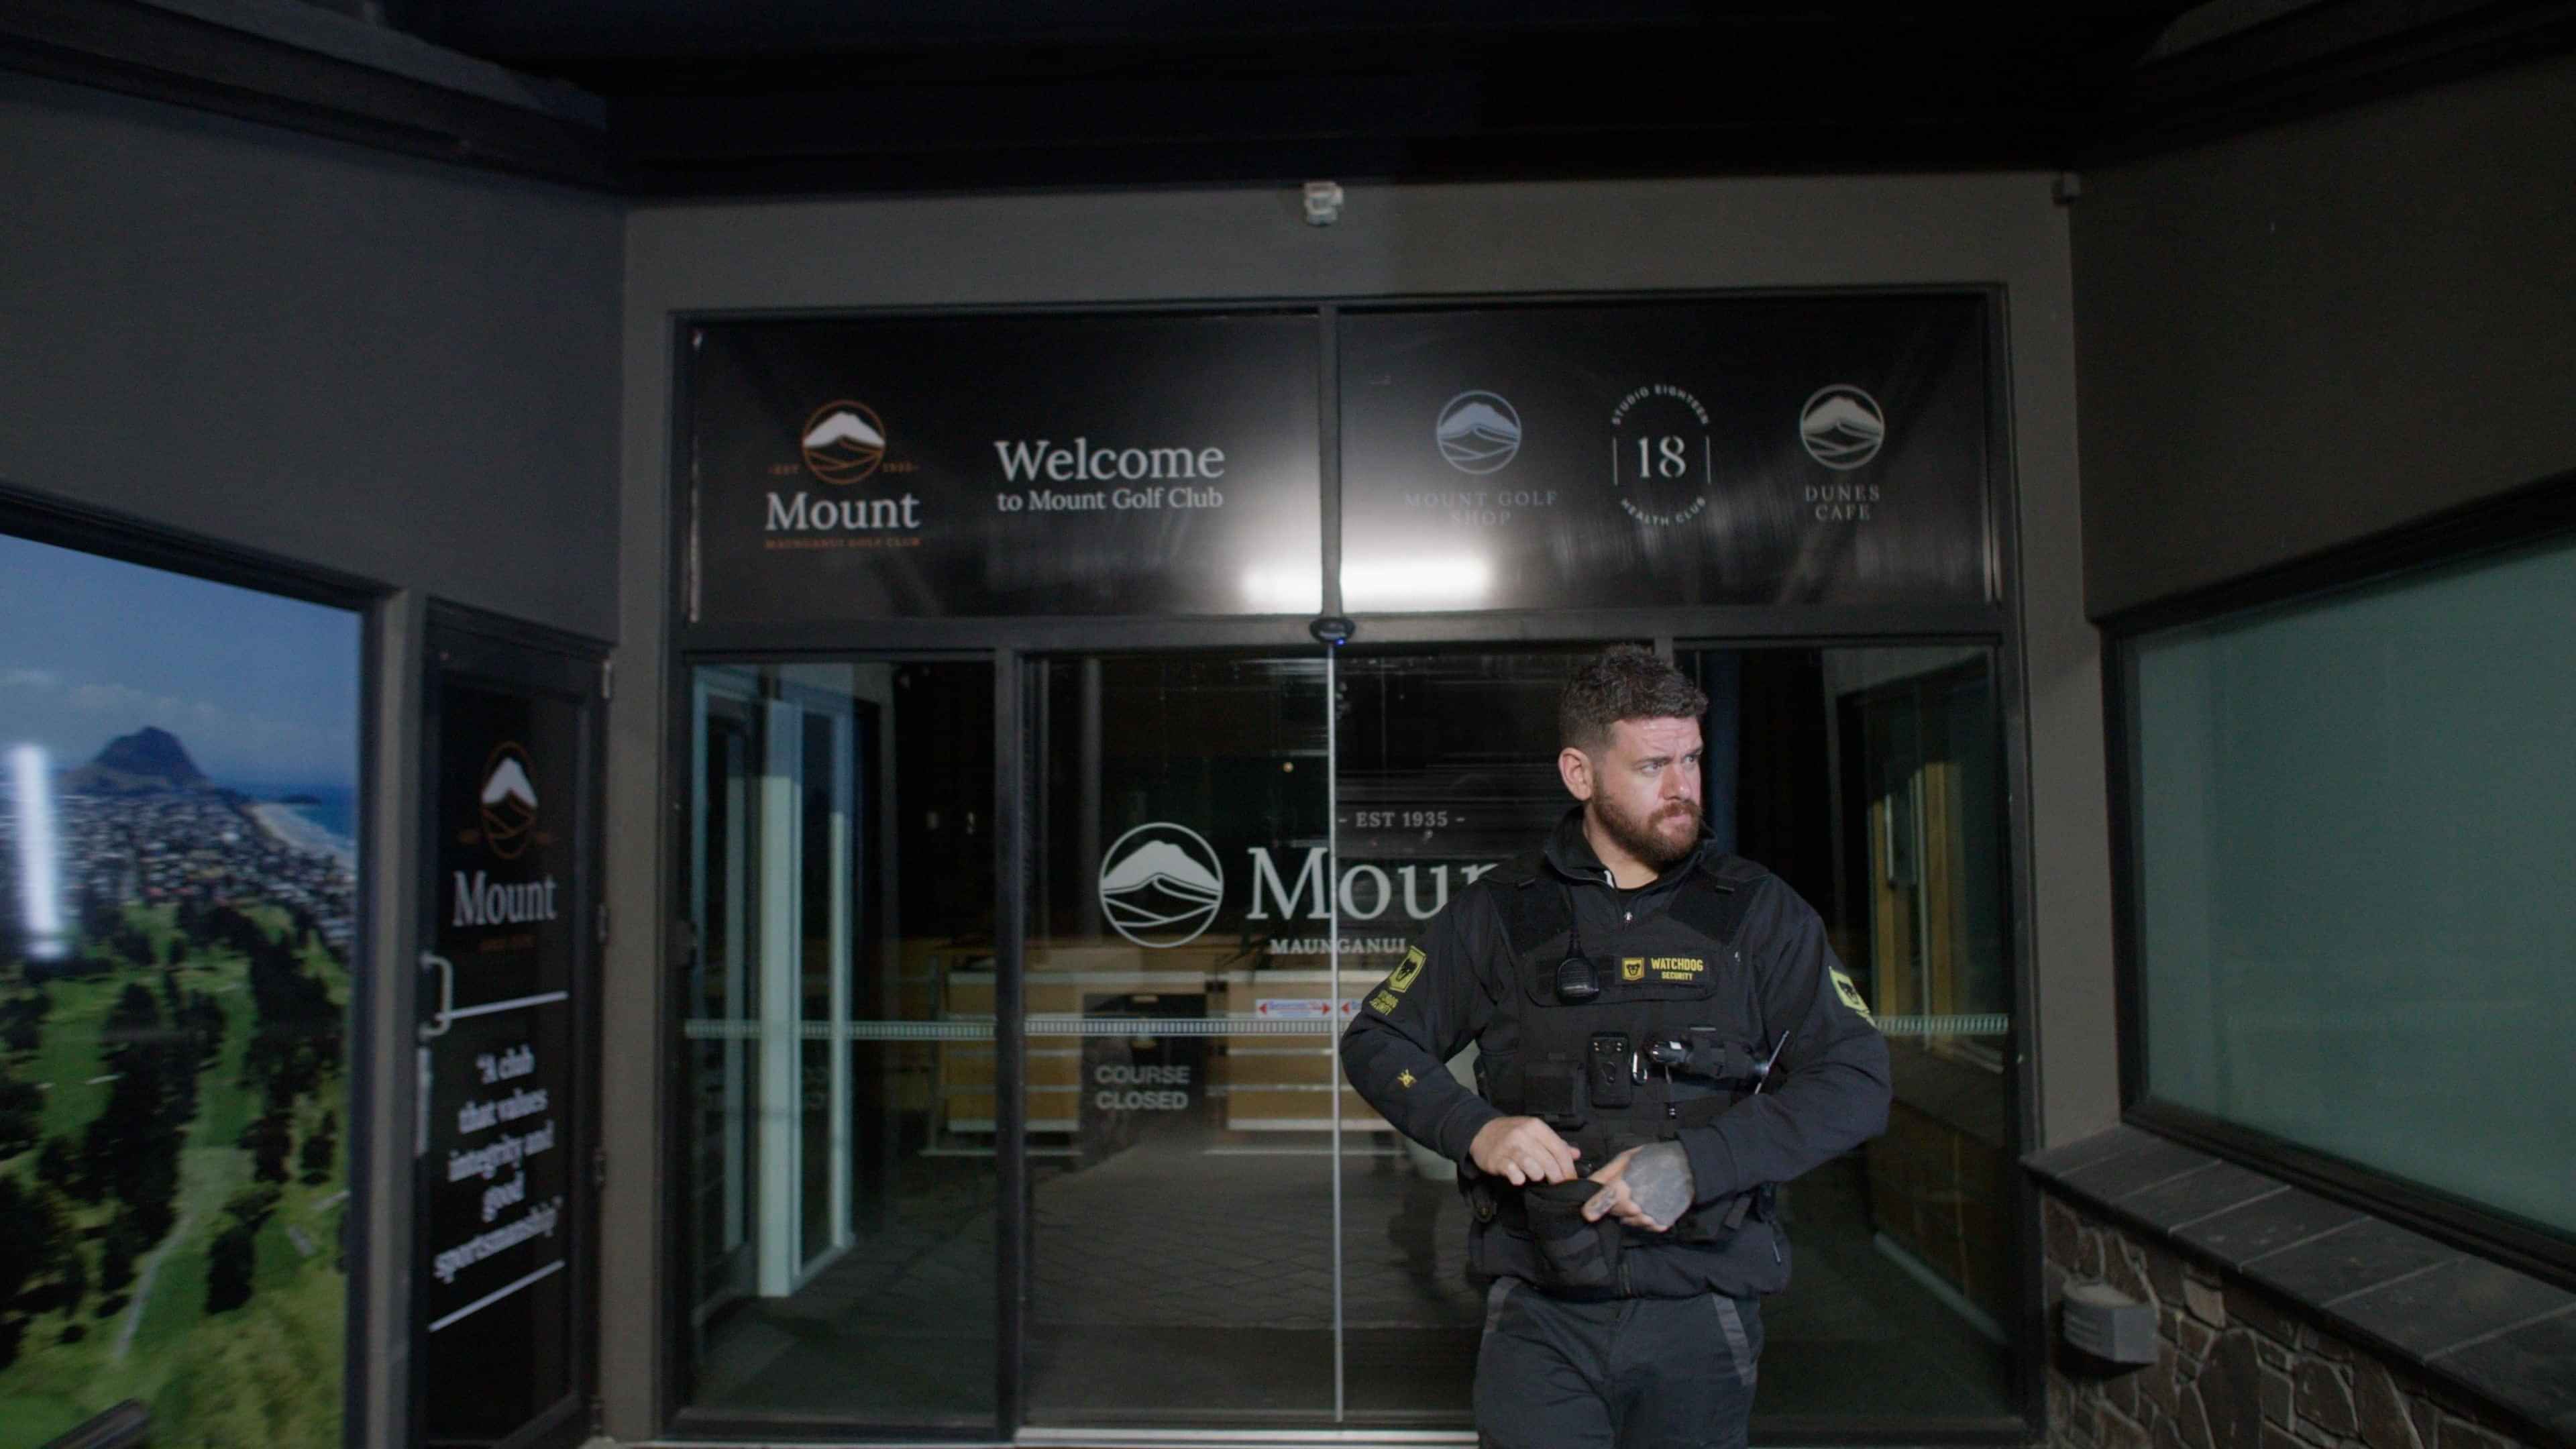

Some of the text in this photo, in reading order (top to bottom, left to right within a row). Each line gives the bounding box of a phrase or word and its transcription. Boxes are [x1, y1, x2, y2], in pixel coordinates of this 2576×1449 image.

[1611, 383, 1709, 425] STUDIO EIGHTEEN
[994, 437, 1225, 481] Welcome
[1638, 435, 1686, 478] 18
[998, 487, 1224, 511] to Mount Golf Club
[1405, 490, 1557, 507] MOUNT GOLF
[1805, 484, 1880, 502] DUNES
[765, 491, 921, 530] Mount
[1621, 496, 1707, 526] HEALTH CLUB
[1815, 504, 1870, 521] CAFE
[1356, 810, 1448, 827] EST 1935
[1246, 847, 1499, 920] Mou
[453, 870, 558, 927] Mount
[1270, 938, 1407, 955] MAUNGANUI
[1651, 957, 1704, 972] WATCHDOG
[1662, 971, 1693, 981] SECURITY
[1095, 1065, 1191, 1085] COURSE
[1095, 1090, 1189, 1110] CLOSED
